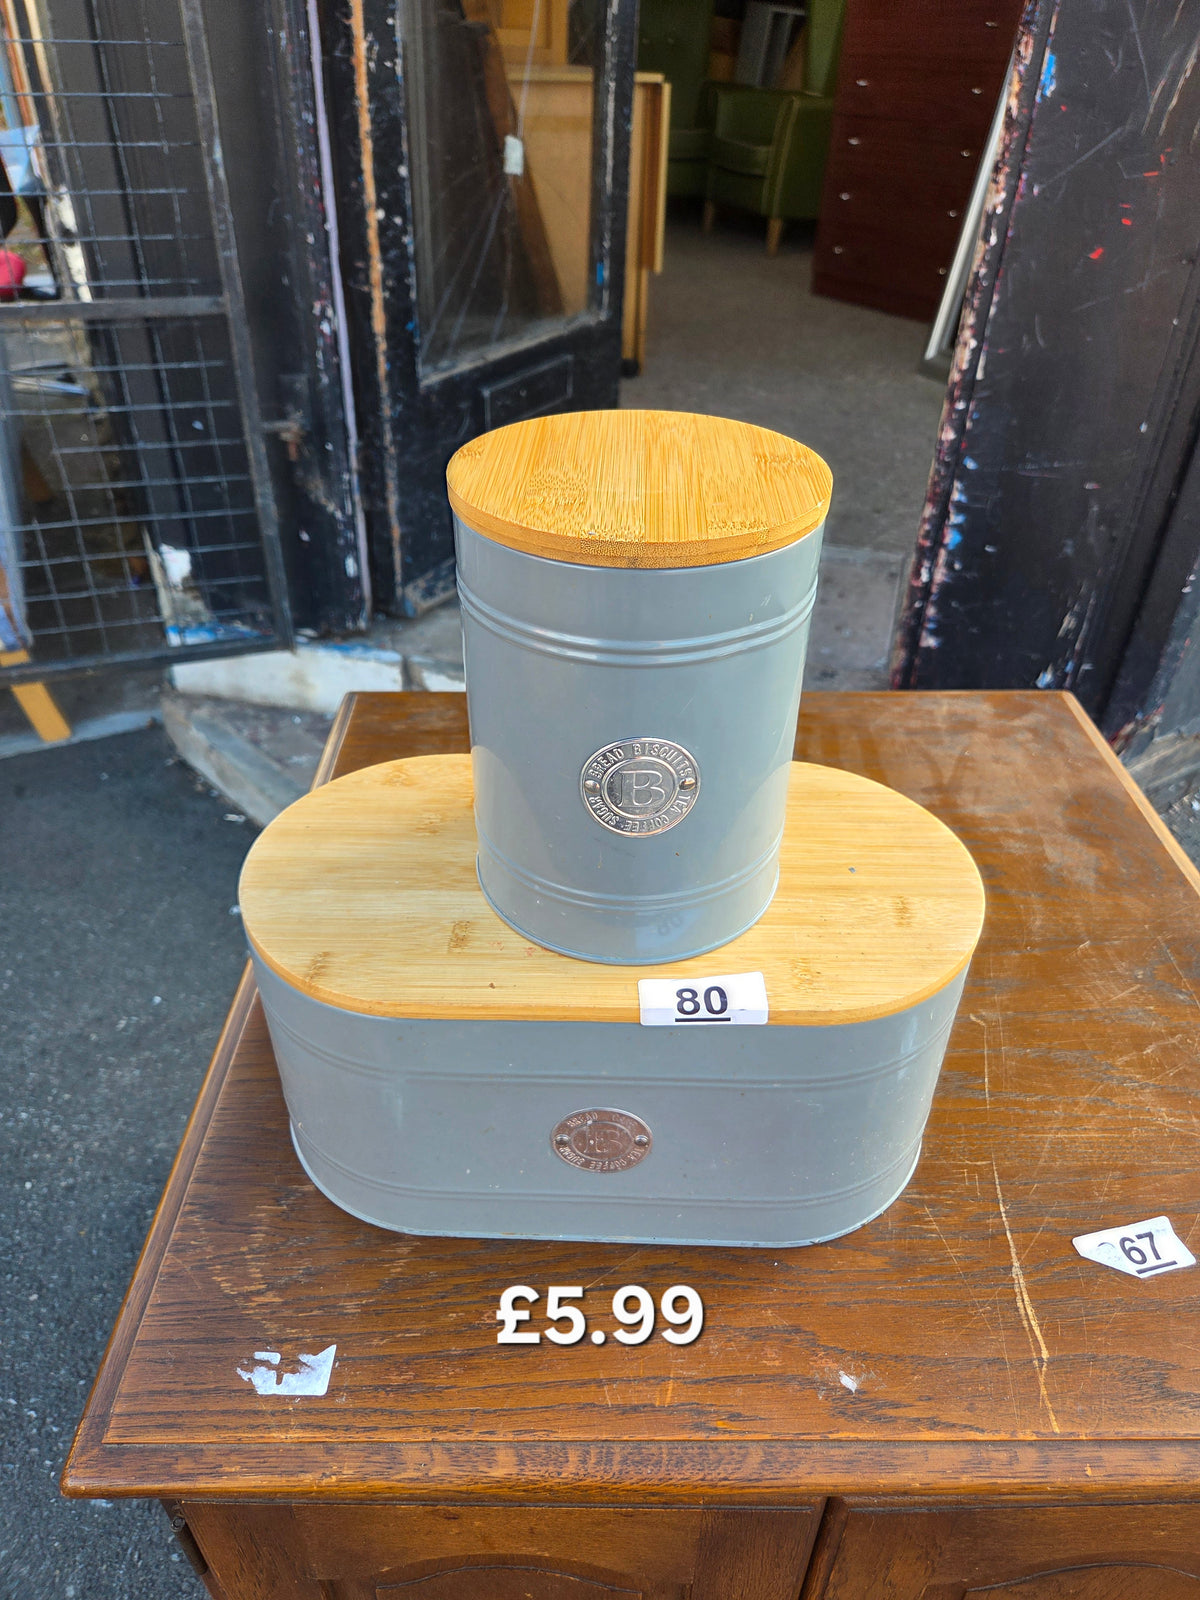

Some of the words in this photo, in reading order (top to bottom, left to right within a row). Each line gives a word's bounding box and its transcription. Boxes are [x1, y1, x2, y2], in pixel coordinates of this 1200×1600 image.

[588, 748, 625, 779] BREAD
[633, 743, 693, 777] BISCUITS
[588, 795, 620, 826] SUGAR
[669, 794, 692, 814] TEA
[675, 985, 728, 1016] 80
[1119, 1231, 1162, 1265] 67
